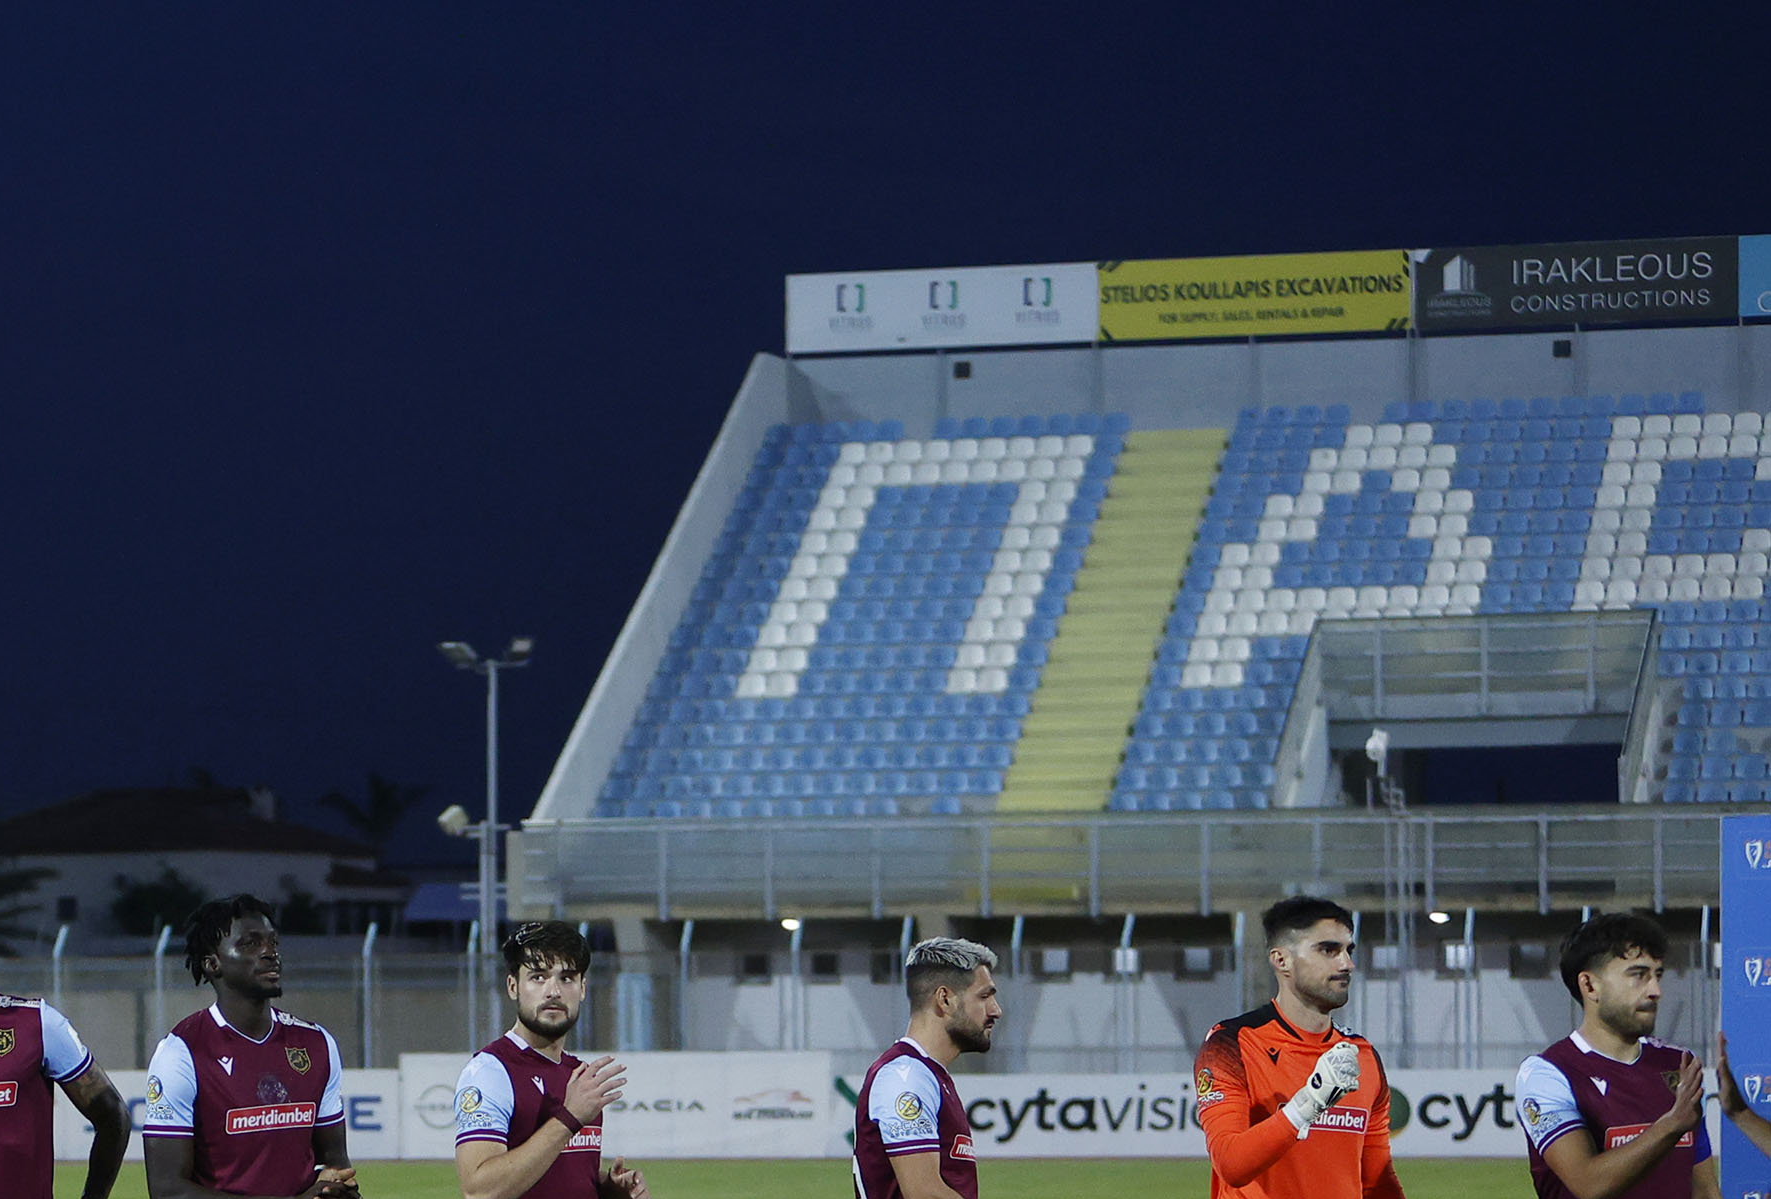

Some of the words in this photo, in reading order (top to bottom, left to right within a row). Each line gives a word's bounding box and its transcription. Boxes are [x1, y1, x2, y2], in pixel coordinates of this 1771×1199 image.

[1512, 252, 1714, 285] IRAKLEOUS
[1100, 284, 1171, 304] STELIOS
[1173, 279, 1271, 301] KOULLAPIS
[1276, 274, 1404, 298] EXCAVATIONS
[1510, 288, 1711, 314] CONSTRUCTIONS
[232, 1102, 314, 1130] meridianbet
[1418, 1083, 1515, 1141] cyt
